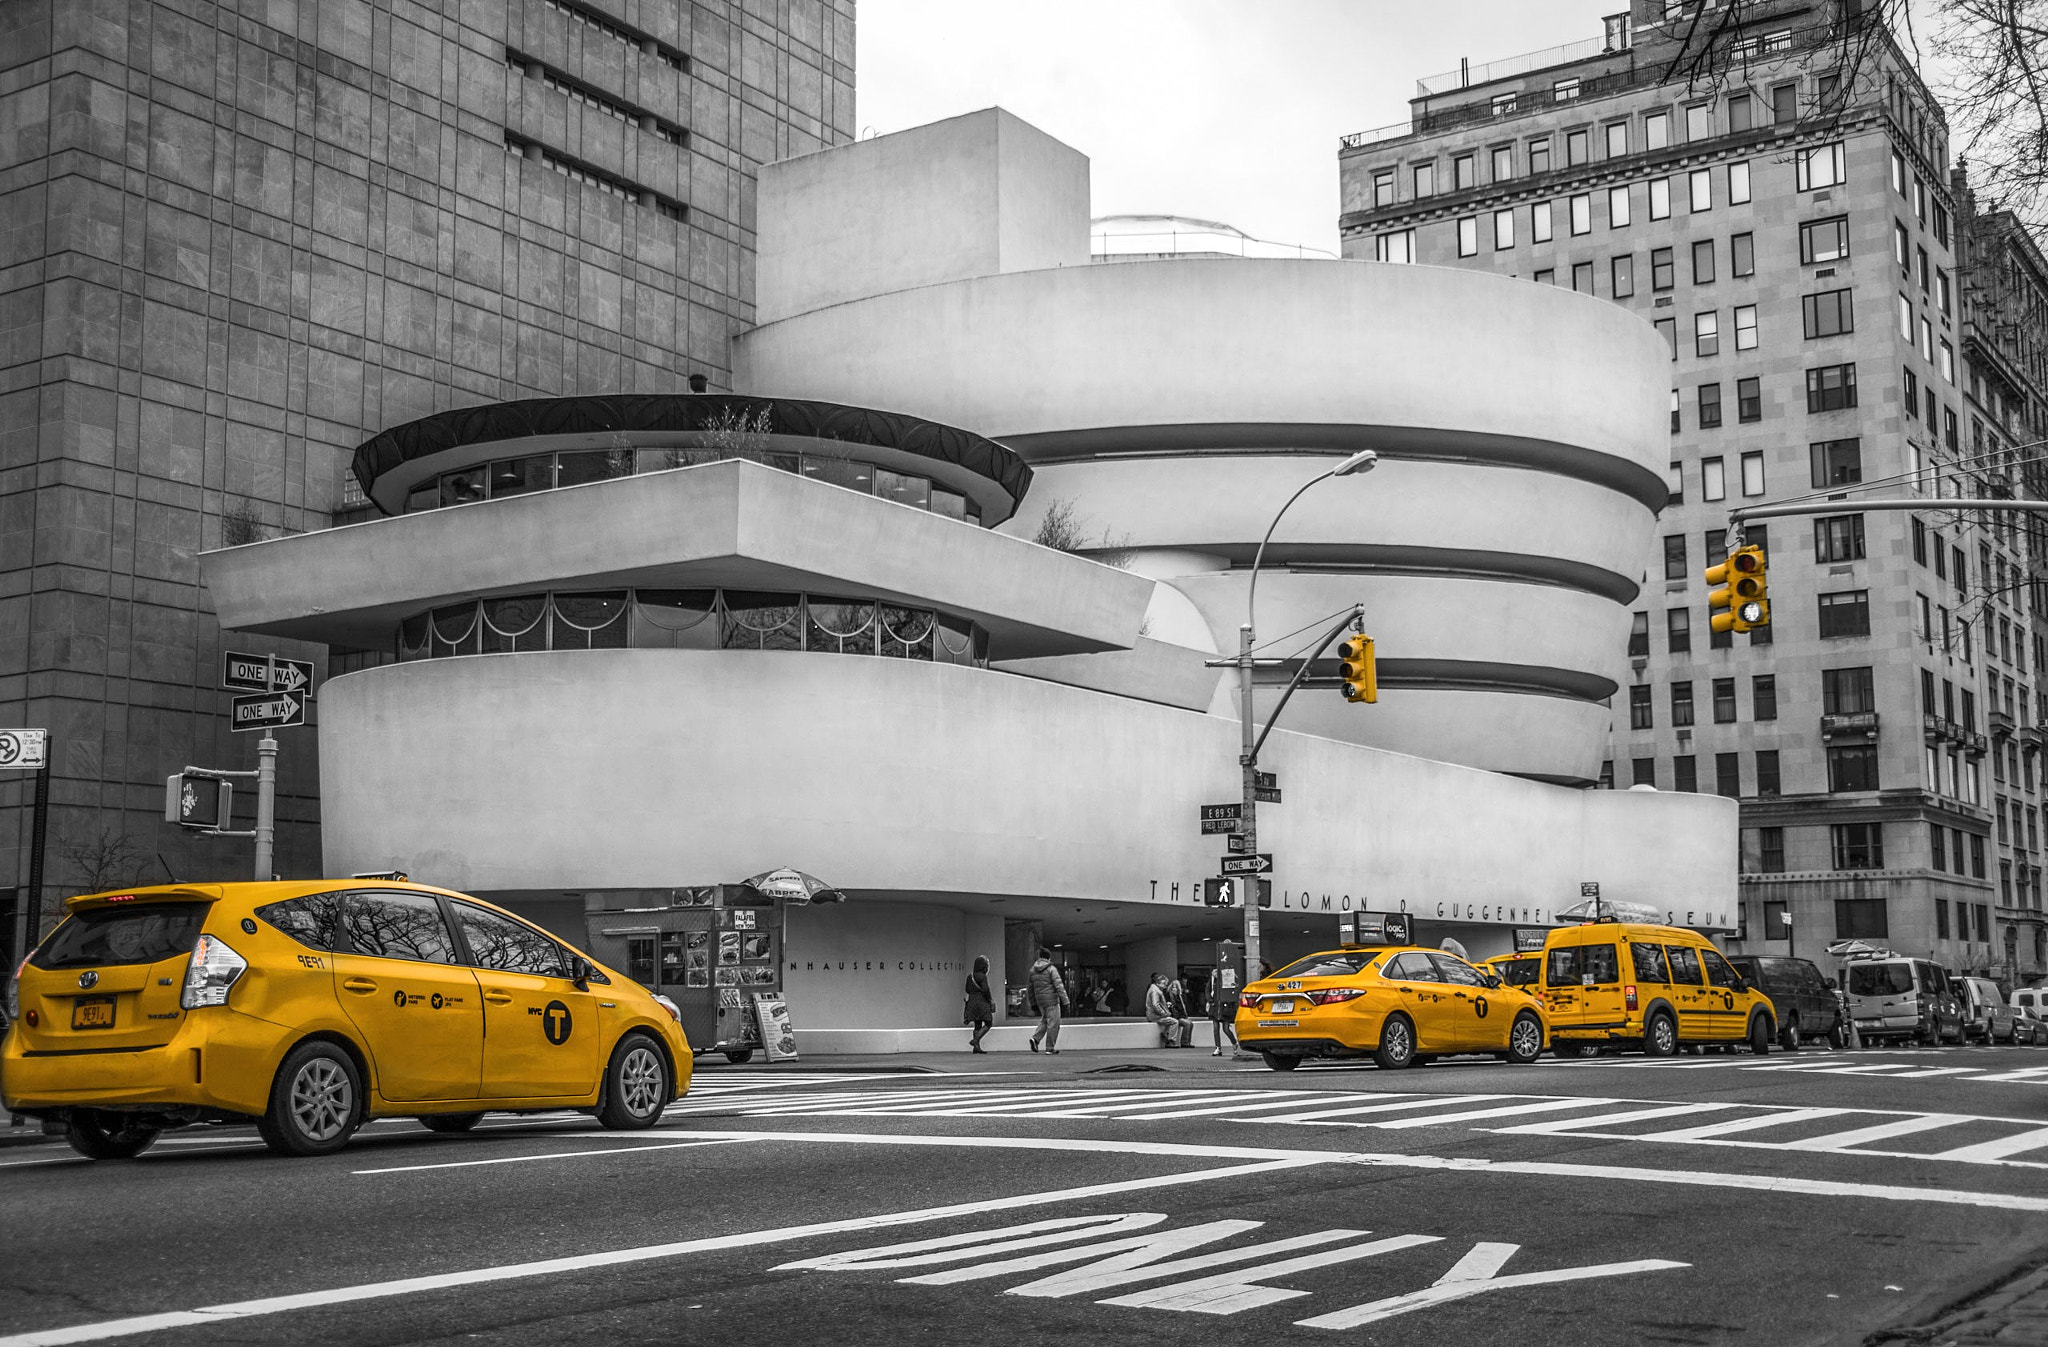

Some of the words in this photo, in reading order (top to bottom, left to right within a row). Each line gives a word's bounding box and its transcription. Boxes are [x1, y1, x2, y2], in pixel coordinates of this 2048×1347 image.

[238, 664, 263, 680] ONE
[274, 669, 300, 684] WAY
[242, 704, 263, 719] ONE
[271, 701, 293, 716] WAY
[1208, 809, 1213, 818] E
[1215, 808, 1224, 818] 89
[1226, 807, 1234, 818] St
[1202, 821, 1216, 830] FRED
[1228, 861, 1243, 870] ONE
[1249, 860, 1263, 869] WAY
[1150, 880, 1201, 902] THE
[1284, 890, 1367, 912] LOMON
[1437, 902, 1550, 924] GUGGENHEI
[1667, 911, 1727, 926] SEUM
[297, 955, 325, 970] 9E91
[790, 962, 885, 971] NHAUSER
[1287, 981, 1301, 989] 427
[527, 1006, 543, 1016] NYC
[549, 1008, 566, 1040] T
[767, 1212, 1694, 1330] ONLY
